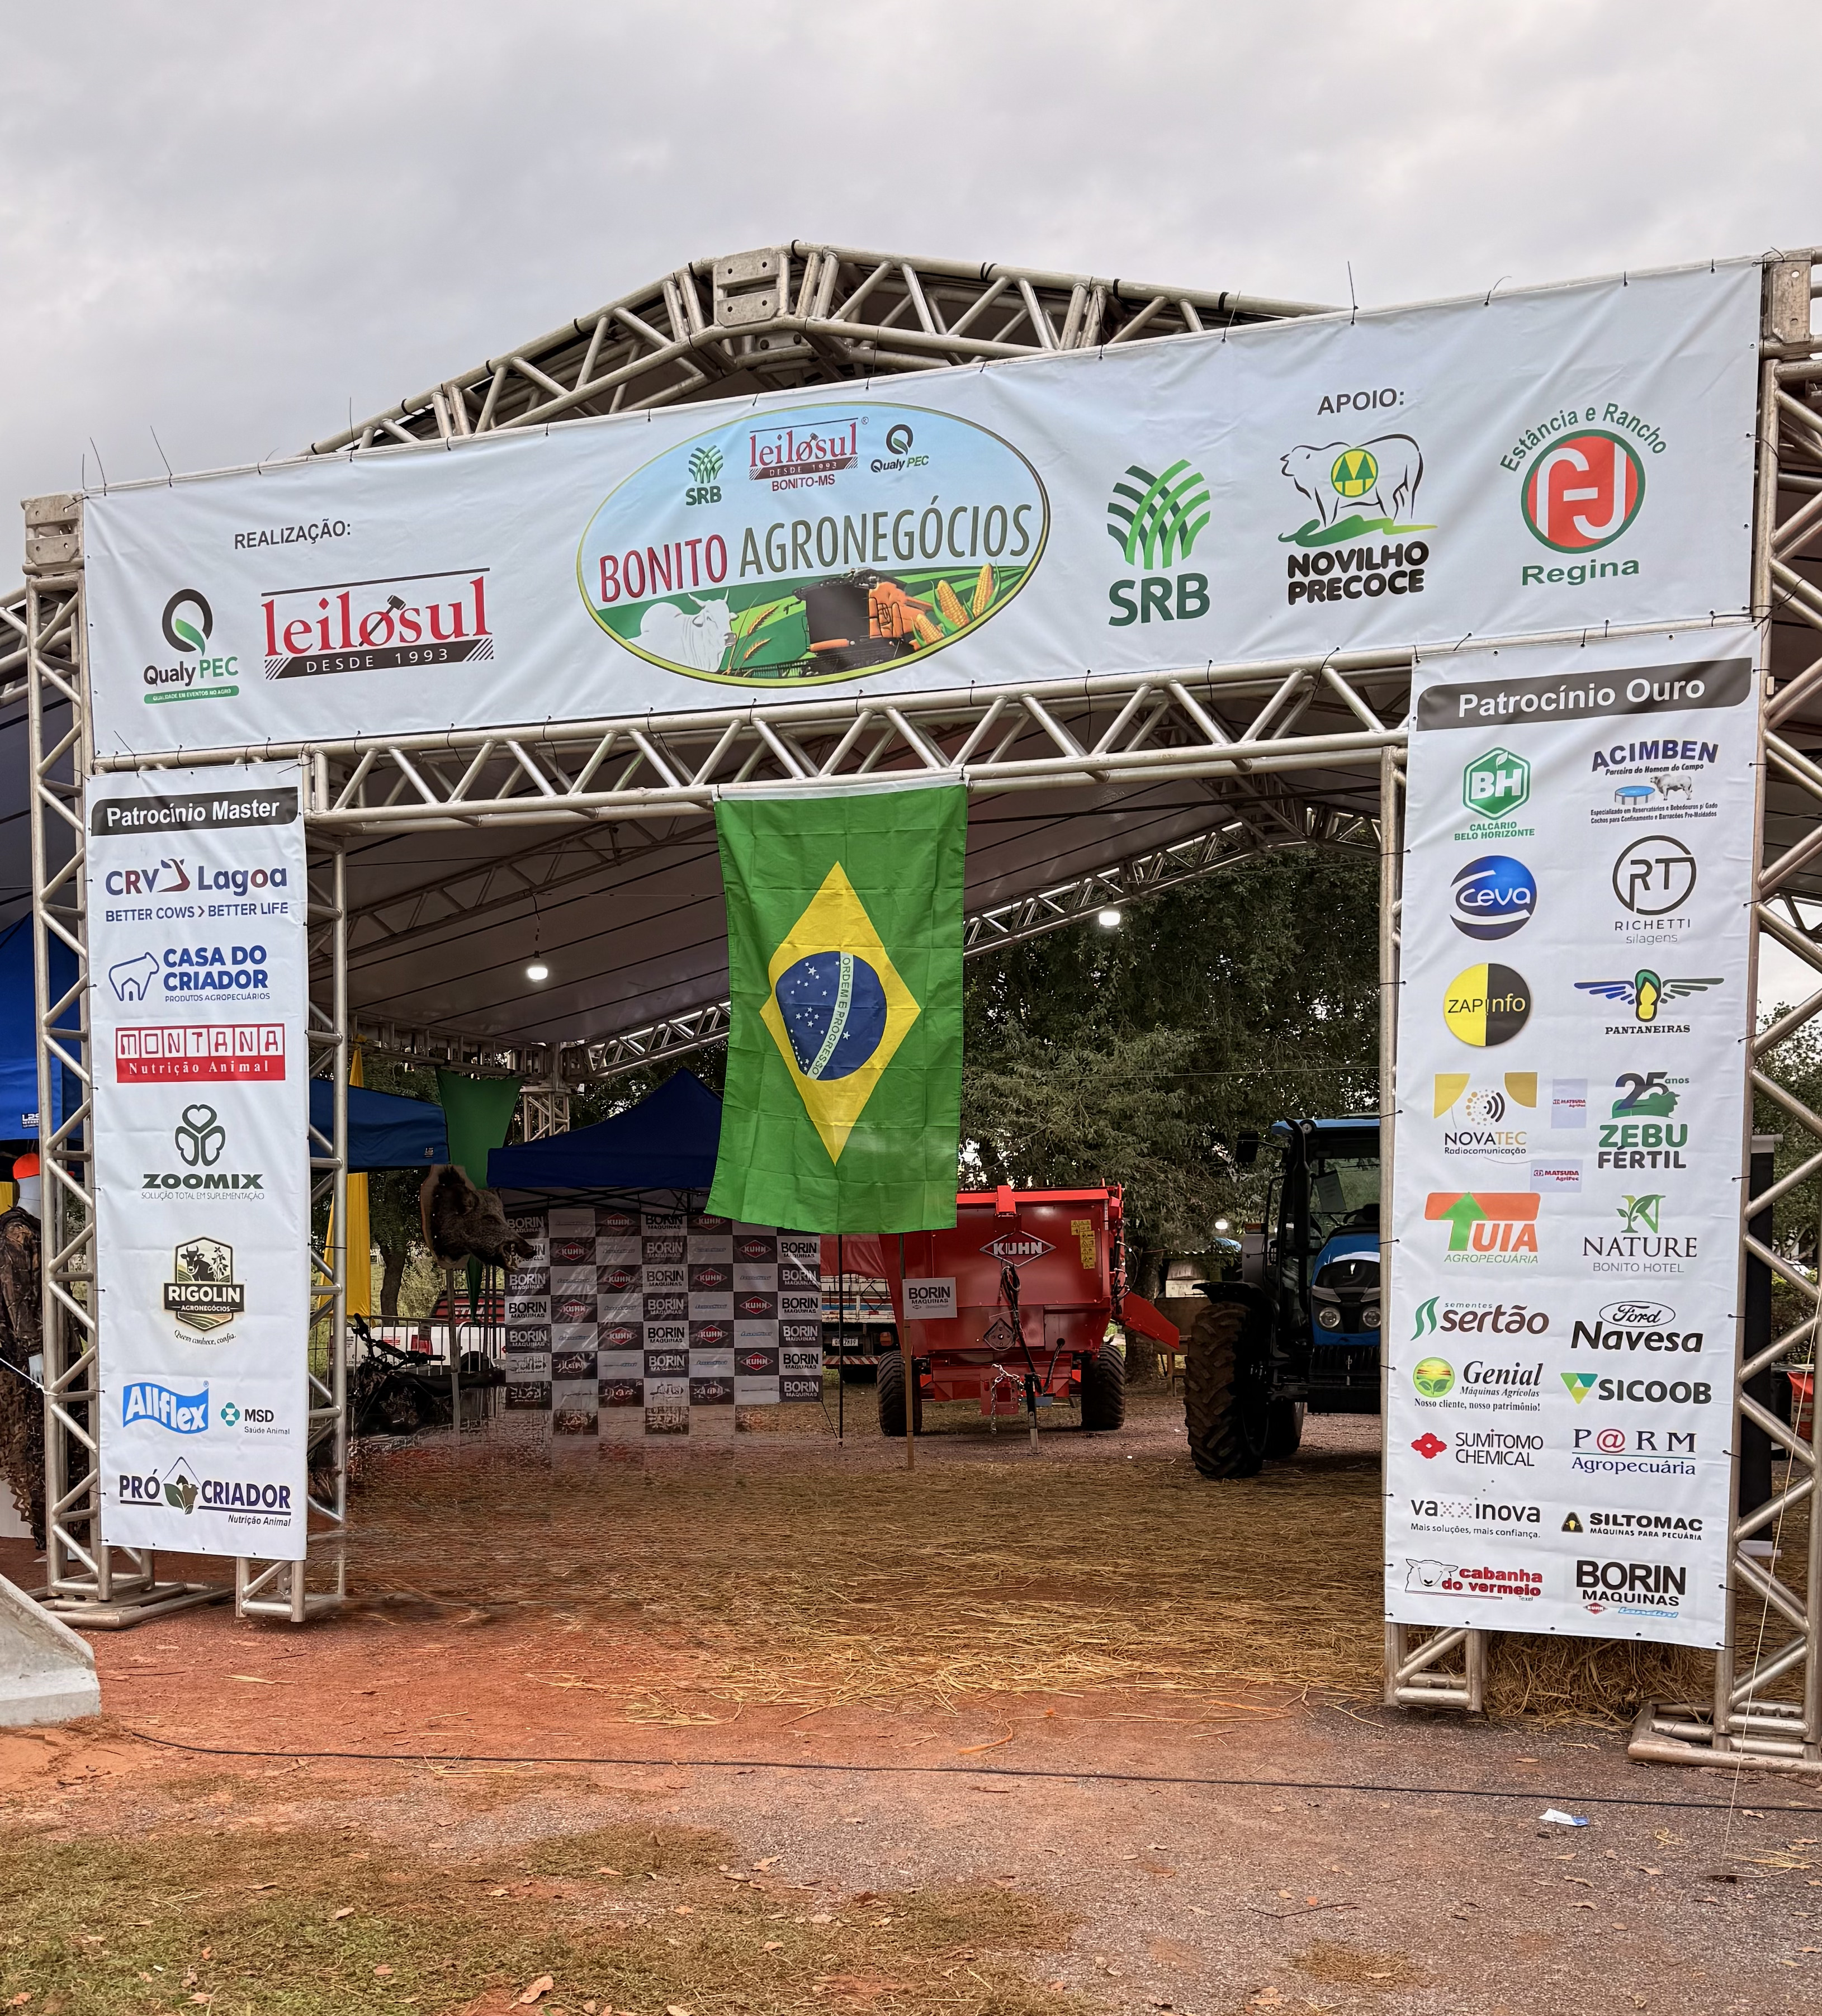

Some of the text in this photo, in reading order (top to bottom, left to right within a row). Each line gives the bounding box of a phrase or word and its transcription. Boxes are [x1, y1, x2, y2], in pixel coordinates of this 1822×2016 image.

[1317, 388, 1405, 415] APOIO:
[1499, 403, 1667, 472] Estância e Rancho
[769, 461, 837, 476] DESDE 1993
[870, 455, 929, 474] Qualy PEC
[772, 474, 835, 491] BONITO-MS
[685, 485, 722, 506] SRB
[234, 518, 351, 549] REALIZAÇÃO:
[599, 494, 1031, 603] BONITO AGRONEGÓCIOS
[1288, 541, 1429, 579] NOVILHO
[1522, 559, 1640, 586] Regina
[1288, 569, 1425, 605] PRECOCE
[1109, 572, 1210, 626] SRB
[307, 647, 449, 673] DESDE 1993
[144, 656, 239, 687] Qualy PEC
[153, 692, 178, 701] QUALIDADE
[1459, 678, 1706, 718] Patrocínio Ouro
[1592, 740, 1719, 772] ACIMBEN
[1471, 768, 1522, 799] BH
[107, 798, 280, 827] Patrocínio Master
[1455, 829, 1535, 841] BELO HORIZONTE
[1470, 821, 1517, 831] CALCÁRIO
[105, 865, 287, 897] CRV Lagoa
[1459, 887, 1531, 906] ceva
[106, 902, 288, 922] BETTER COWS BETTER LIFE
[1615, 919, 1691, 931] RICHETTI
[1626, 933, 1678, 945] silagens
[163, 945, 267, 968] CASA DO
[163, 969, 268, 992] CRIADOR
[840, 957, 850, 998] ORDEM
[165, 992, 270, 1002] PRODUTOS AGROPECUÁRIOS
[1605, 1025, 1691, 1035] PANTANEIRAS
[120, 1030, 278, 1055] MONTANA
[812, 1010, 845, 1075] PROGRESSO
[129, 1061, 268, 1076] Nutrição Animal
[1615, 1072, 1669, 1110] 25
[1445, 1132, 1527, 1146] NOVATEC
[1599, 1124, 1687, 1148] ZEBU
[1445, 1147, 1526, 1156] Radiocomunicação
[1598, 1144, 1687, 1169] FÉRTIL
[141, 1173, 264, 1189] ZOOMIX
[141, 1191, 173, 1201] SOLUÇÃO
[207, 1191, 264, 1201] SUPLEMENTAÇÃO
[993, 1242, 1042, 1255] KUHN
[1582, 1237, 1697, 1258] NATURE
[1444, 1253, 1538, 1263] AGROPECUÁRIA
[1593, 1263, 1684, 1273] BONITO HOTEL
[168, 1286, 240, 1303] RIGOLIN
[908, 1286, 950, 1299] BORIN
[181, 1304, 230, 1312] AGRONEGÓCIOS
[509, 1301, 547, 1313] BORIN
[1613, 1304, 1662, 1323] Ford
[1440, 1304, 1549, 1334] sertão
[174, 1329, 191, 1343] Quem
[1571, 1321, 1703, 1352] Navesa
[783, 1354, 818, 1365] BORIN
[1463, 1361, 1543, 1386] Genial
[1460, 1386, 1540, 1398] Máquinas Agrícolas
[1598, 1379, 1711, 1404] SICOOB
[125, 1386, 206, 1431] Allflex
[1414, 1398, 1437, 1407] Nosso
[1439, 1400, 1466, 1409] cliente,
[1493, 1402, 1540, 1411] patrimônio!
[244, 1409, 274, 1422] MSD
[244, 1426, 265, 1434] Saúde
[1456, 1431, 1543, 1450] SUMITOMO
[1456, 1449, 1535, 1466] CHEMICAL
[1572, 1457, 1696, 1475] Agropecuária
[119, 1469, 290, 1509] PRÓ CRIADOR
[1411, 1497, 1541, 1523] vaxxinova
[228, 1514, 291, 1527] Nutrição Animal
[1589, 1513, 1703, 1531] SILTOMAC
[1432, 1524, 1471, 1534] soluções,
[1496, 1529, 1541, 1539] confiança.
[1591, 1527, 1634, 1536] MÁQUINAS
[1662, 1532, 1702, 1540] PECUÁRIA
[1442, 1578, 1463, 1590] do
[1459, 1567, 1543, 1583] cabanha
[1577, 1560, 1686, 1595] BORIN
[1582, 1590, 1679, 1606] MAQUINAS
